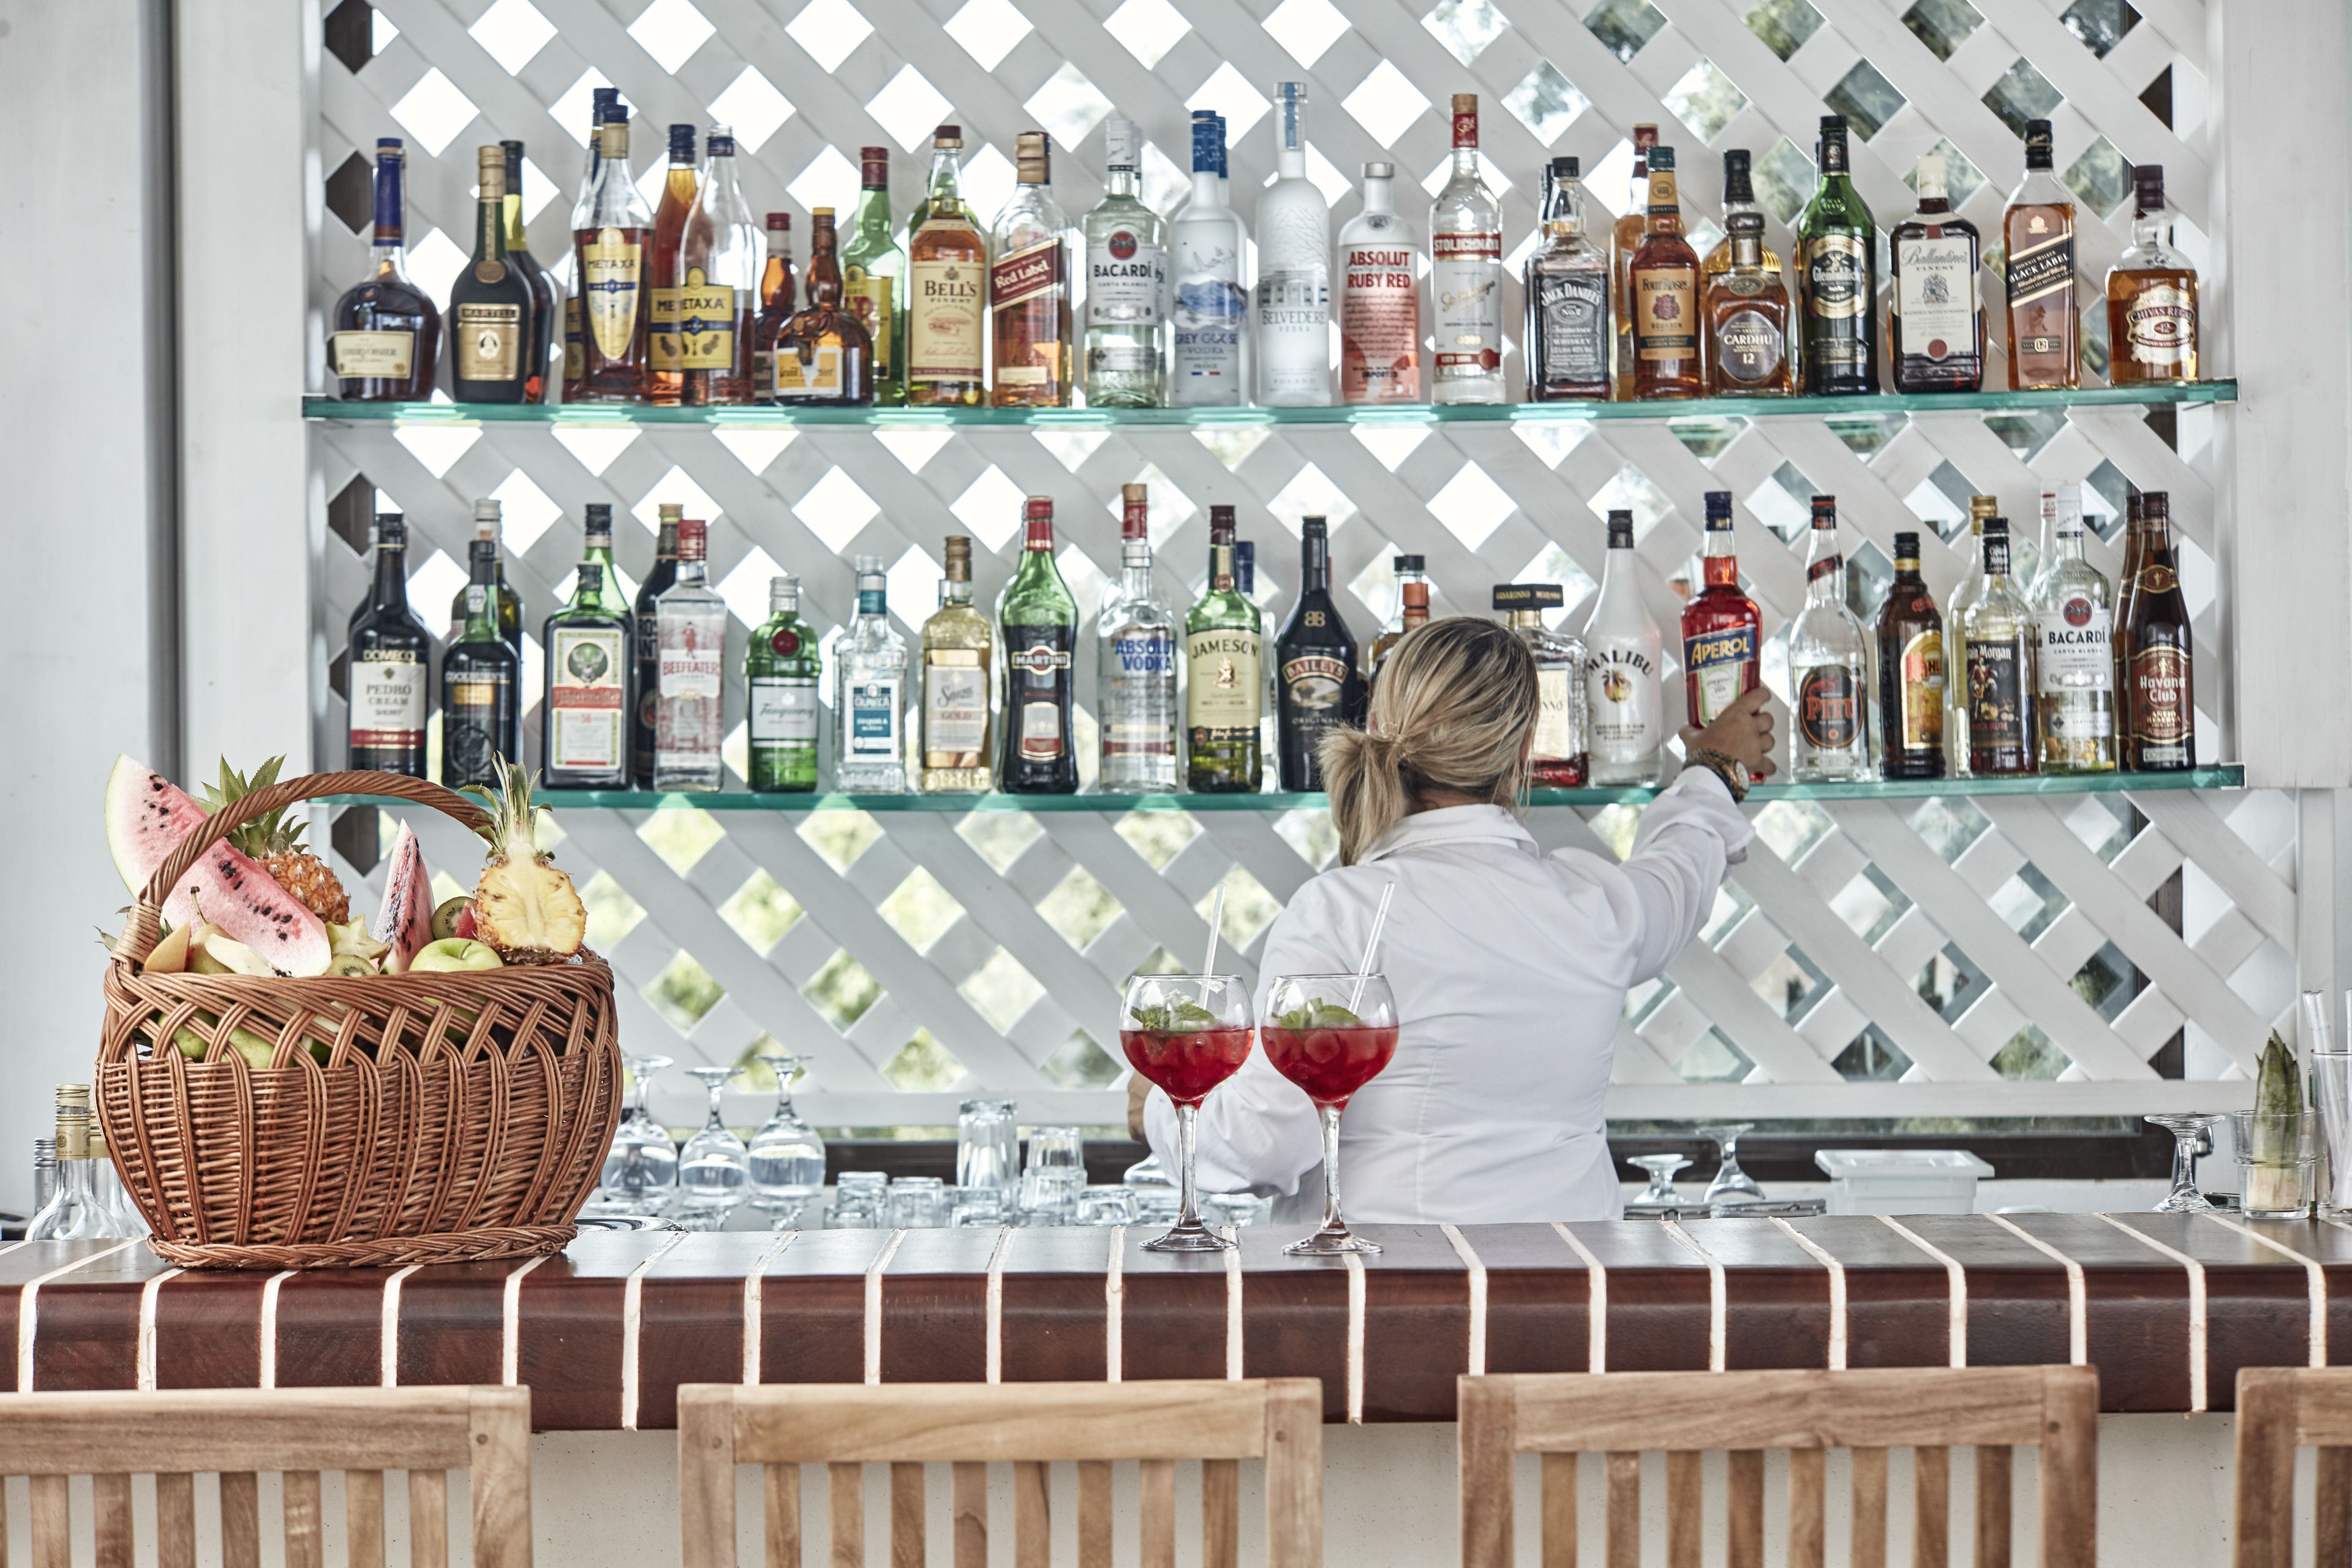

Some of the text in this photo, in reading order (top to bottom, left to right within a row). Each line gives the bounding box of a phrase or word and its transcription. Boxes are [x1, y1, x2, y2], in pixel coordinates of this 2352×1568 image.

[587, 259, 636, 270] METAXA
[1349, 252, 1410, 266] ABSOLUT
[994, 259, 1050, 289] Red Label
[2008, 252, 2070, 283] BLACK LABEL
[924, 279, 978, 296] BELL'S
[1348, 274, 1411, 288] RUBY RED
[1642, 277, 1690, 291] Four Roses
[1540, 287, 1565, 306] JACK
[1262, 309, 1326, 325] BELVEDERE
[2130, 307, 2165, 322] CHIVAS
[1724, 334, 1773, 345] CARDHU
[1743, 352, 1755, 364] 12
[2049, 627, 2106, 644] BACARDÍ
[1115, 639, 1177, 655] ABSOLUT
[1193, 639, 1257, 659] JAMESON
[1691, 636, 1750, 666] APEROL
[1978, 645, 2011, 661] Morgan
[363, 649, 416, 662] DOMECQ
[1016, 655, 1066, 665] MARTINI
[1123, 655, 1173, 671] VODKA
[663, 662, 720, 676] BEEFEATER
[1286, 660, 1345, 679] BAILEYS
[1587, 649, 1654, 679] MALIBU
[366, 684, 412, 695] PEDRO
[2140, 674, 2186, 690] Havana
[2149, 689, 2177, 703] Club
[759, 703, 816, 719] Tanqueray
